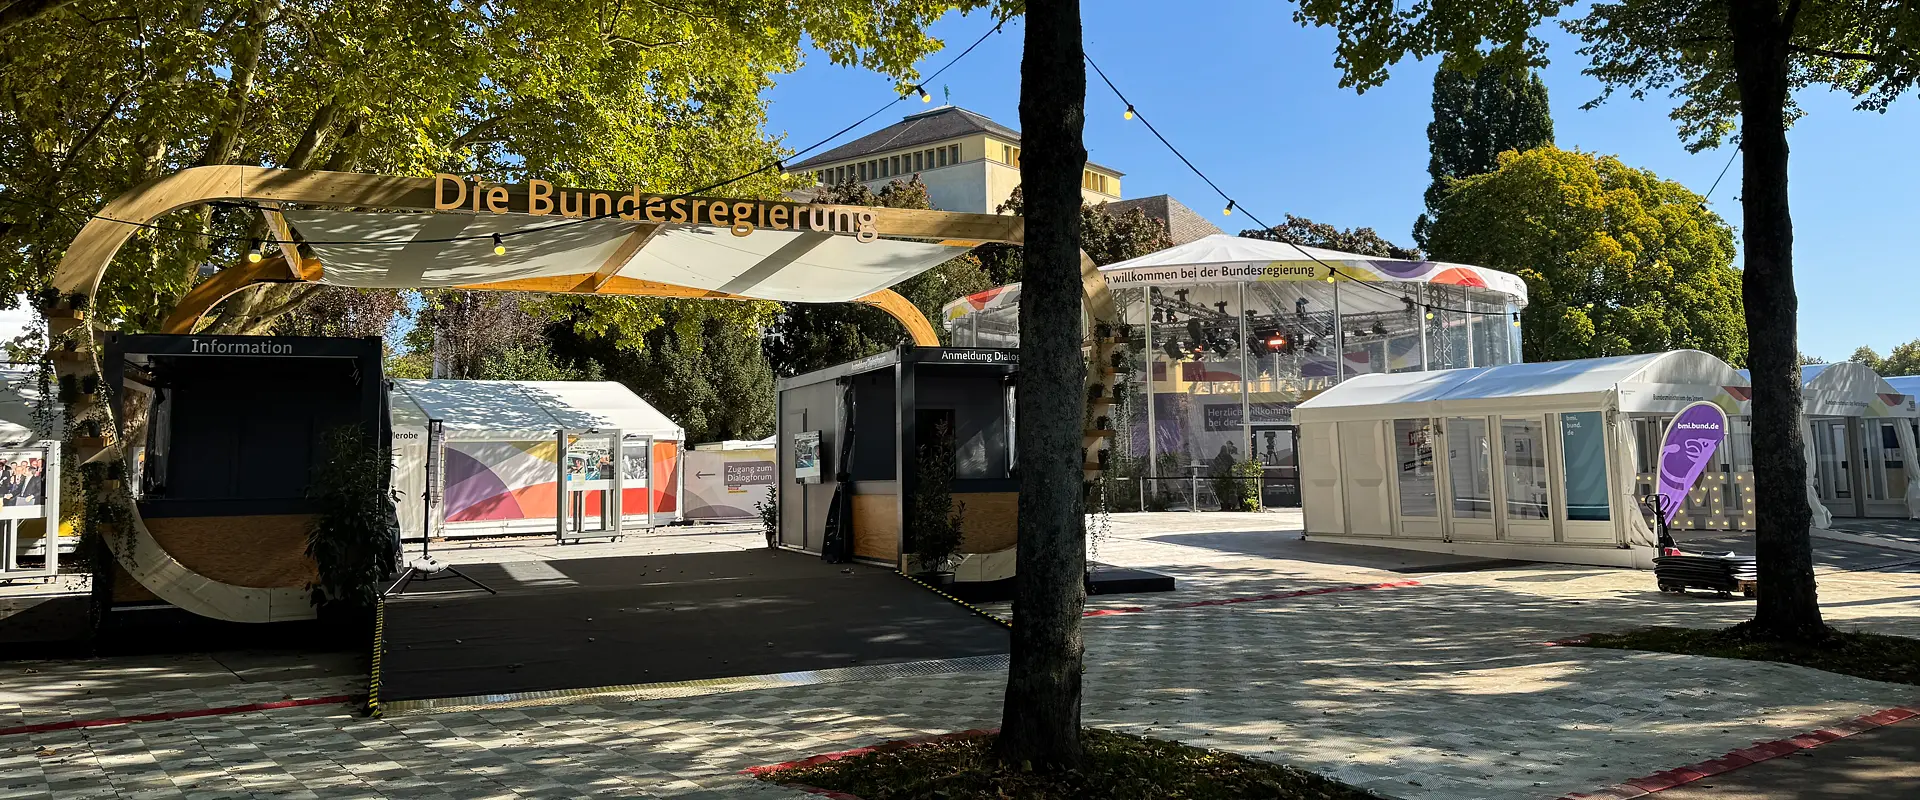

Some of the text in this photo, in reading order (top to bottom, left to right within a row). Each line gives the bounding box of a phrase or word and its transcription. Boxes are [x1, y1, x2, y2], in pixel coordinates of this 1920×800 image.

[434, 173, 879, 243] Die Bundesregierung
[1112, 271, 1177, 284] willkommen
[1180, 267, 1197, 278] bei
[1200, 266, 1218, 277] der
[1221, 264, 1315, 278] Bundesregierung
[191, 339, 293, 354] Information
[941, 350, 993, 363] Anmeldung
[727, 465, 755, 474] Zugang
[727, 474, 772, 483] Dialogforum
